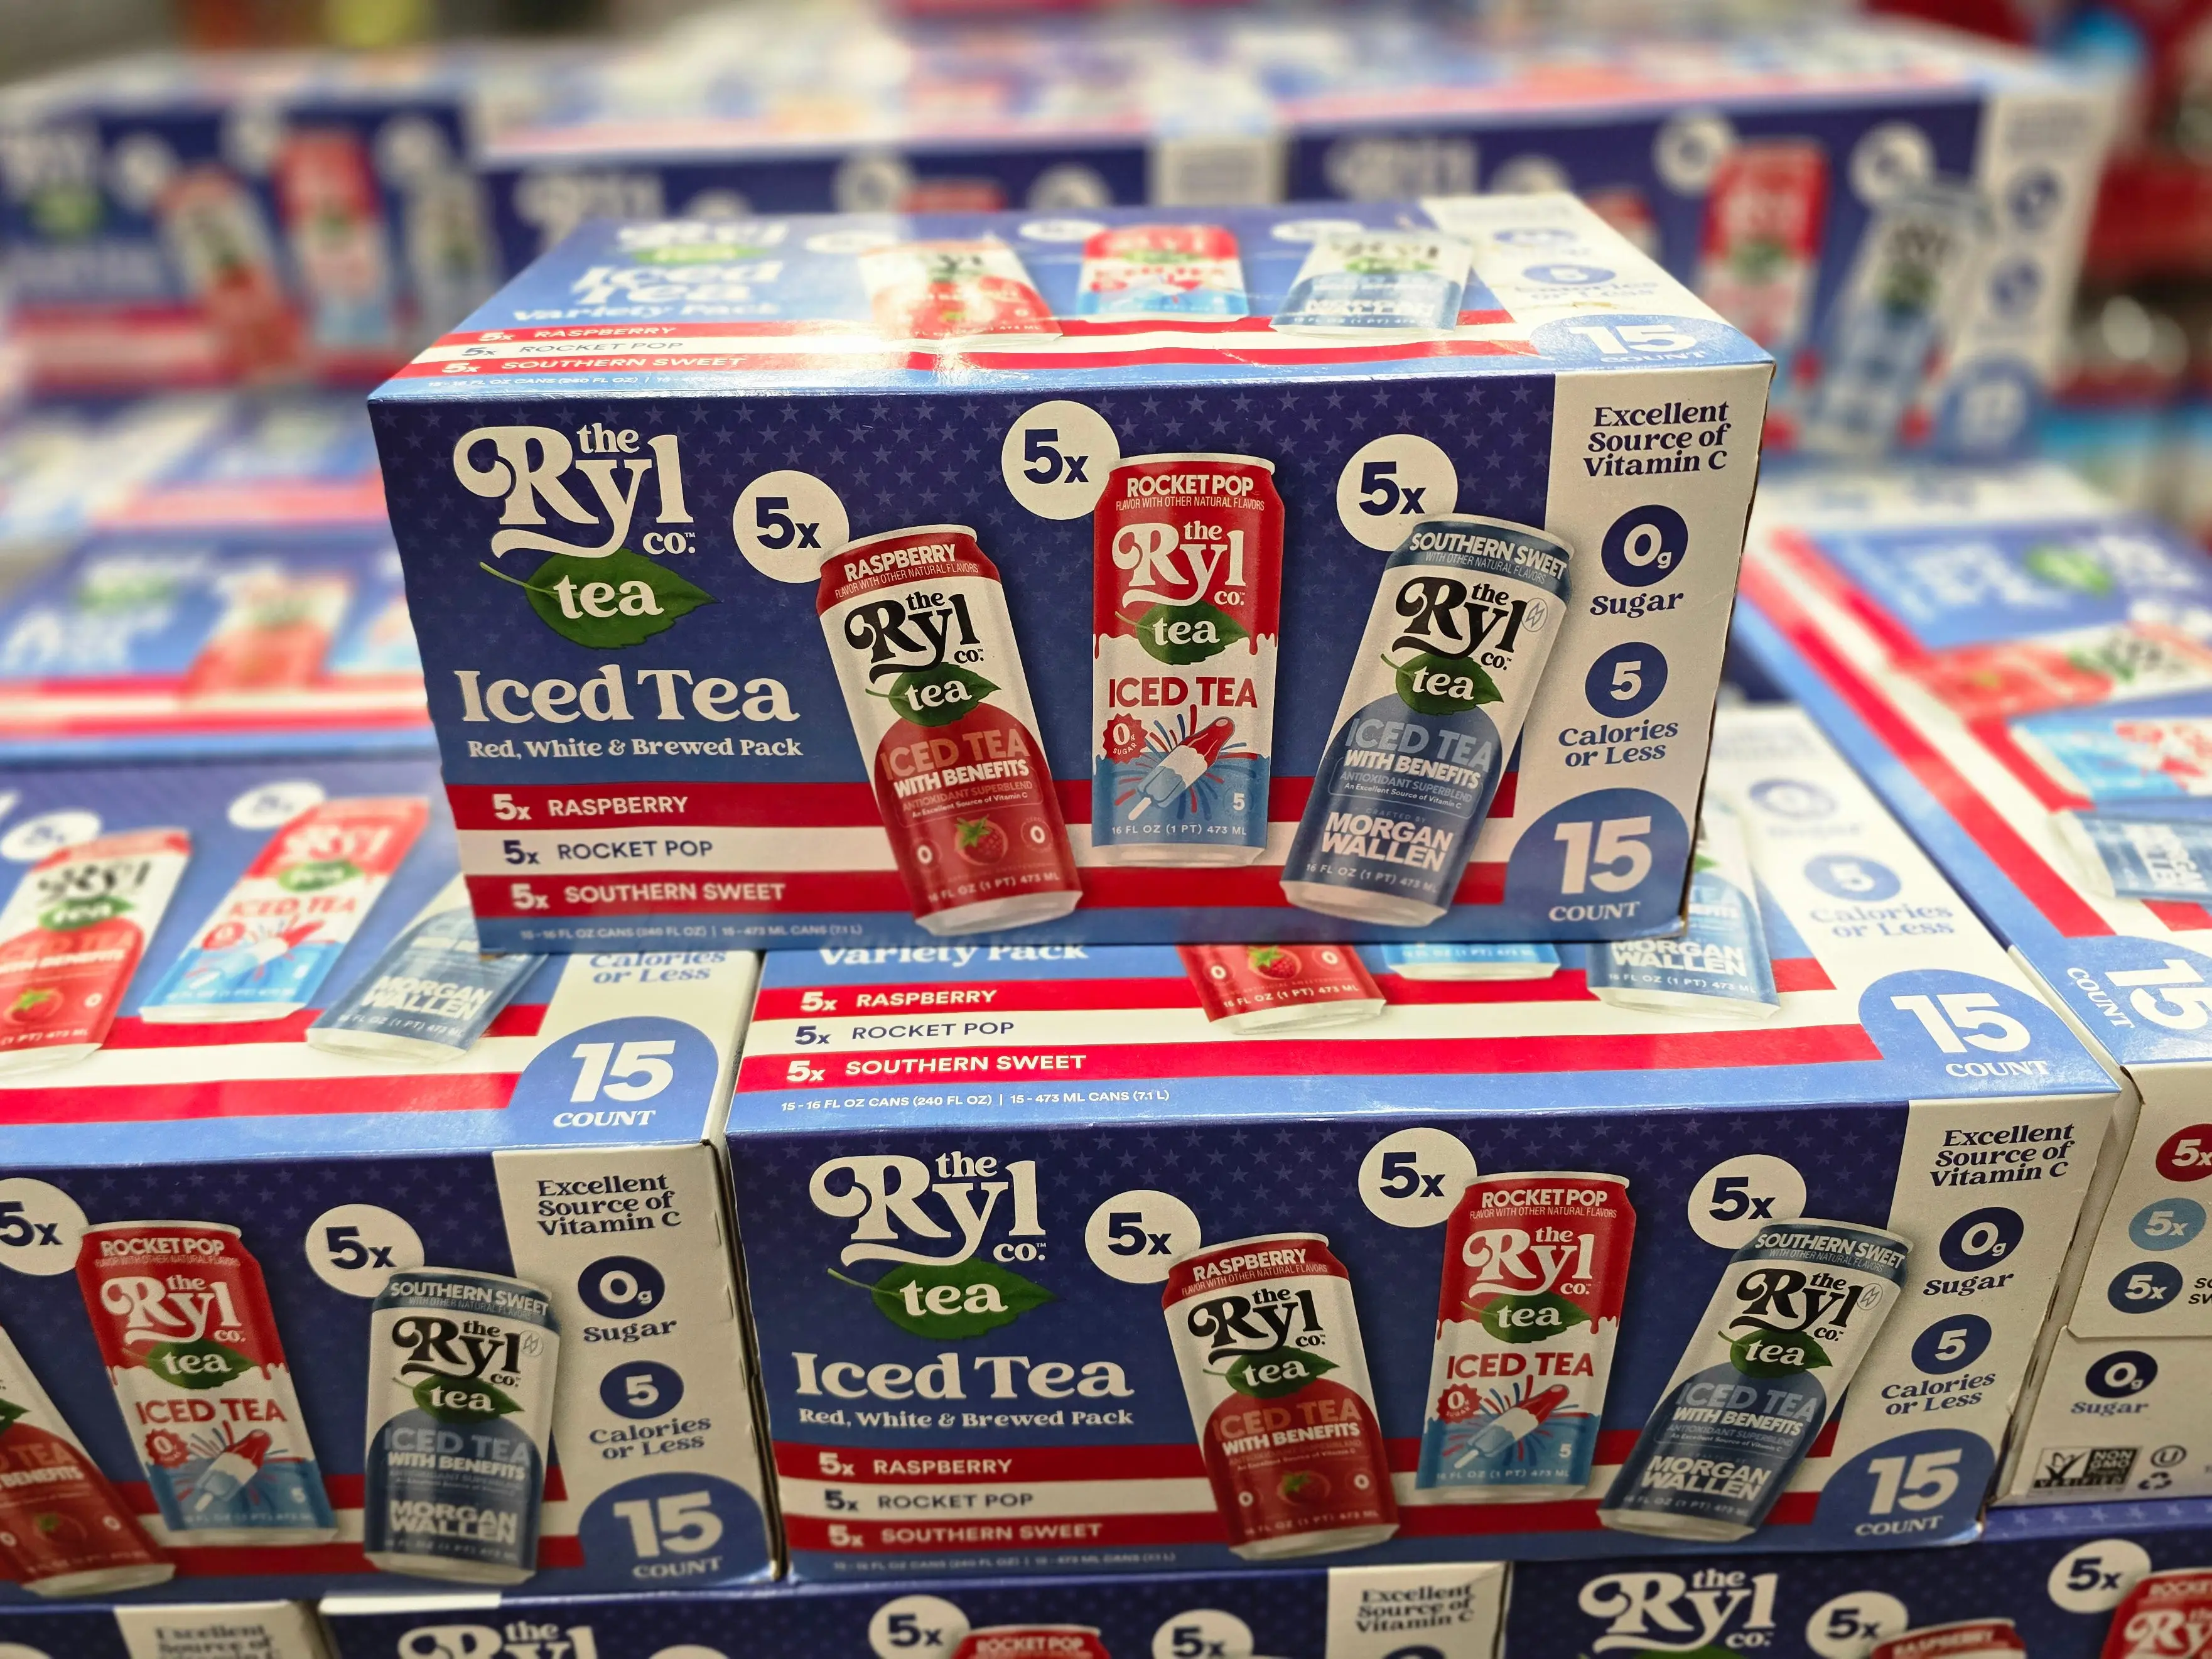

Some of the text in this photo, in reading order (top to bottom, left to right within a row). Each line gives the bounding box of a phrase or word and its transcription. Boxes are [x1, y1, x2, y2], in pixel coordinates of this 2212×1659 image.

[534, 327, 676, 338] RASPBERRY
[1568, 325, 1697, 354] 15
[519, 342, 626, 354] ROCKET
[632, 341, 684, 351] POP
[502, 359, 641, 370] SOUTHERN
[652, 357, 746, 367] SWEET
[1594, 401, 1729, 427] Excellent
[576, 423, 640, 454] the
[1588, 424, 1731, 452] Source of
[1023, 428, 1089, 484] 5x
[1583, 450, 1727, 477] Vitamin C
[453, 426, 694, 558] Ryl
[1127, 475, 1253, 497] ROCKET POP
[1359, 461, 1426, 516] 5x
[1116, 497, 1265, 512] FLAVOR WITH OTHER NATURAL FLAVORS
[755, 497, 821, 549] 5x
[1184, 521, 1222, 541] the
[843, 544, 956, 582] RASPBERRY
[1111, 522, 1246, 608] Ryl
[1410, 532, 1567, 580] SOUTHERN SWEET
[1425, 551, 1546, 585] WITH OTHER NATURAL FLAVORS
[835, 563, 979, 599] FLAVOR WITH OTHER NATURAL FLAVORS
[1471, 583, 1509, 605] the
[553, 575, 664, 619] tea
[906, 591, 945, 611] the
[1590, 592, 1684, 619] Sugar
[1392, 576, 1527, 660] Ryl
[844, 593, 981, 684] Ryl
[1152, 619, 1220, 646] tea
[453, 664, 801, 723] Iced Tea
[1109, 676, 1258, 708] ICED TEA
[1411, 666, 1474, 701] tea
[1610, 661, 1642, 701] 5
[904, 679, 972, 711] tea
[1345, 718, 1492, 772] ICED TEA
[1558, 720, 1678, 747] Calories
[467, 738, 804, 760] Red, White & Brewed Pack
[880, 728, 1030, 781] ICED TEA
[1565, 744, 1666, 767] or Less
[893, 759, 1029, 799] WITH BENEFITS
[1344, 750, 1481, 789] WITH BENEFITS
[493, 794, 688, 819] 5x RASPBERRY
[1125, 826, 1138, 834] FL
[1143, 824, 1161, 833] OZ
[1166, 824, 1176, 835] (1
[1182, 824, 1202, 835] PT)
[1207, 826, 1227, 834] 473
[1232, 826, 1247, 835] ML
[1325, 811, 1454, 852] MORGAN
[503, 840, 713, 865] 5x ROCKET POP
[1321, 831, 1447, 872] WALLEN
[1554, 816, 1652, 895] 15
[510, 883, 786, 909] 5x SOUTHERN SWEET
[1548, 901, 1640, 922] COUNT
[801, 990, 997, 1012] 5x RASPBERRY
[2066, 968, 2135, 1029] COUNT
[795, 1022, 1015, 1046] 5x ROCKET POP
[1891, 992, 2031, 1054] 15
[570, 1040, 676, 1102] 15
[786, 1055, 1087, 1083] 5x SOUTHERN SWEET
[1945, 1061, 2049, 1078] COUNT
[824, 1100, 840, 1108] FL
[844, 1098, 865, 1108] OZ
[868, 1098, 909, 1107] CANS
[913, 1096, 943, 1106] (240
[947, 1096, 963, 1105] FL
[967, 1095, 991, 1105] OZ)
[1064, 1093, 1085, 1102] ML
[1088, 1092, 1129, 1101] CANS
[1133, 1091, 1153, 1102] (7.1
[1157, 1090, 1169, 1101] L)
[553, 1110, 656, 1127] COUNT
[1943, 1123, 2074, 1147] Excellent
[936, 1151, 998, 1178] the
[1935, 1140, 2075, 1167] Source of
[537, 1174, 669, 1197] Excellent
[1930, 1161, 2069, 1187] Vitamin C
[538, 1191, 676, 1218] Source of
[809, 1154, 1046, 1267] Ryl
[537, 1211, 682, 1236] Vitamin C
[2144, 1211, 2189, 1236] 5x
[898, 1279, 1008, 1317] tea
[2125, 1274, 2168, 1300] 5x
[1934, 1329, 1967, 1361] 5
[792, 1352, 1135, 1401] Iced Tea
[1881, 1373, 1996, 1399] Calories
[1886, 1390, 1983, 1415] or Less
[1867, 1449, 1963, 1516] 15
[1855, 1516, 1944, 1536] COUNT
[1692, 1568, 1746, 1590] the
[1577, 1571, 1779, 1655] Ryl
